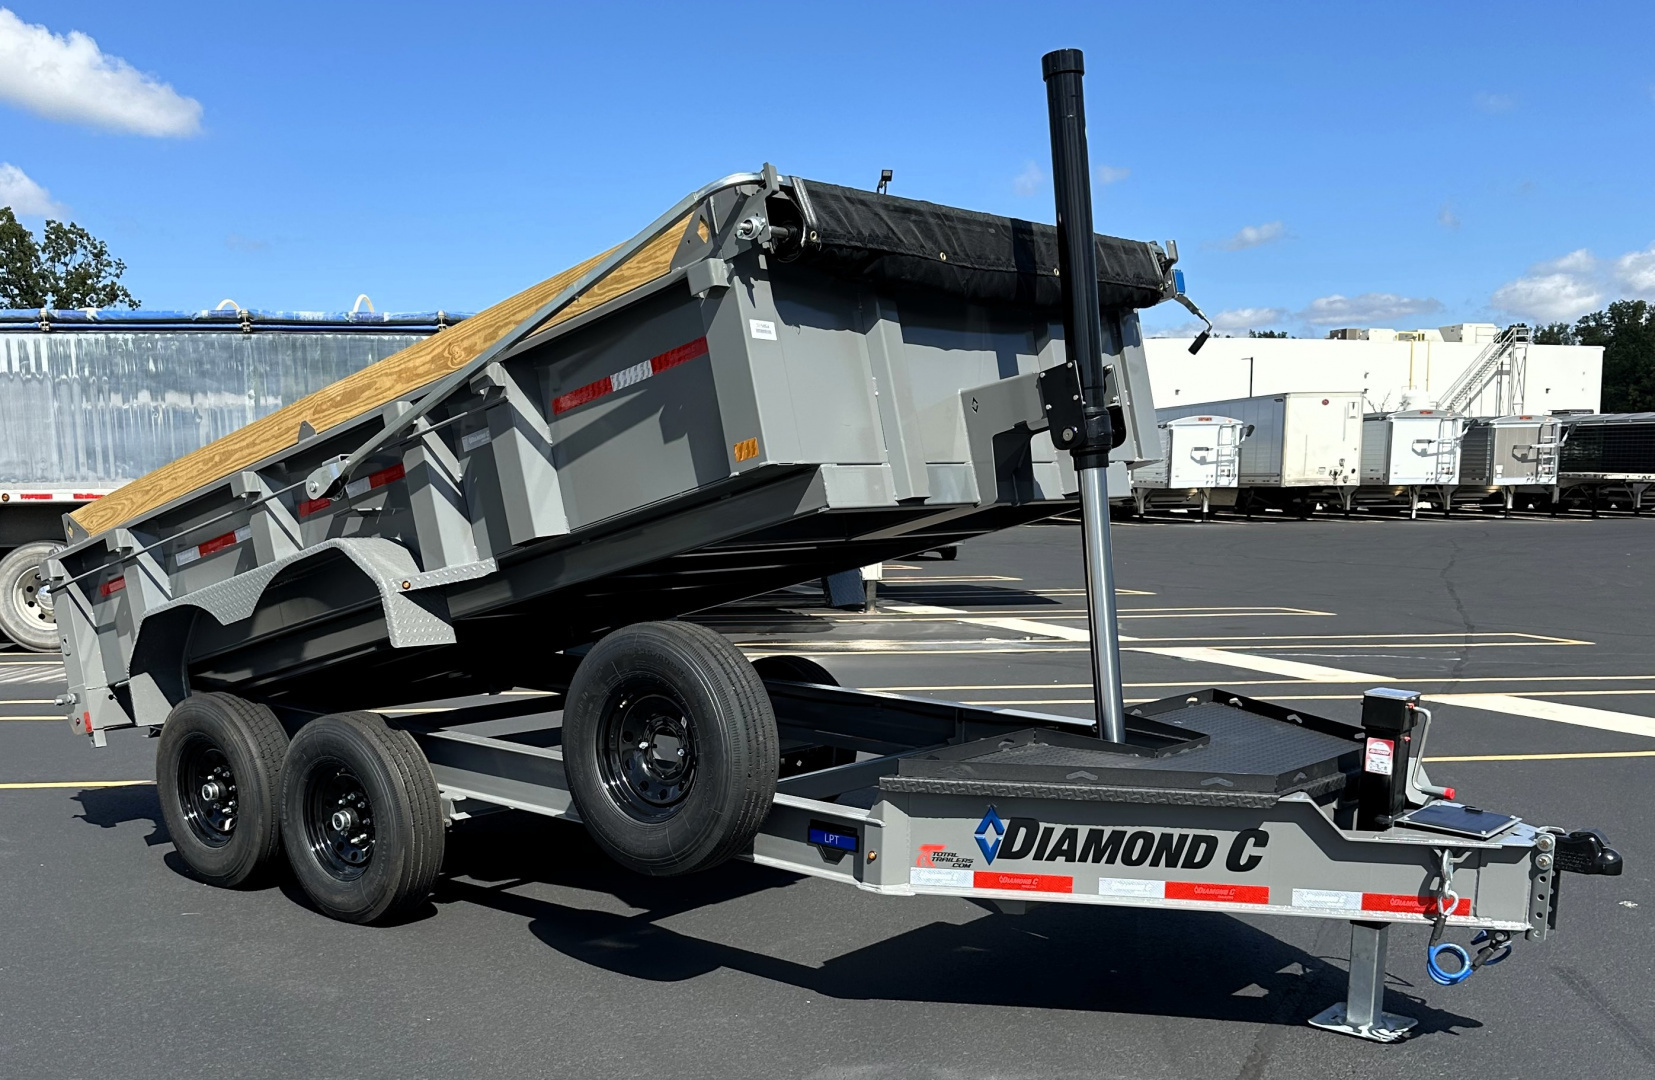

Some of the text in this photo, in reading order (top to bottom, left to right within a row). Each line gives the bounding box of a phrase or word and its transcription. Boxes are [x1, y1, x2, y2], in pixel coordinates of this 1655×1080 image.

[824, 833, 840, 845] LPT
[997, 816, 1270, 872] DIAMOND C
